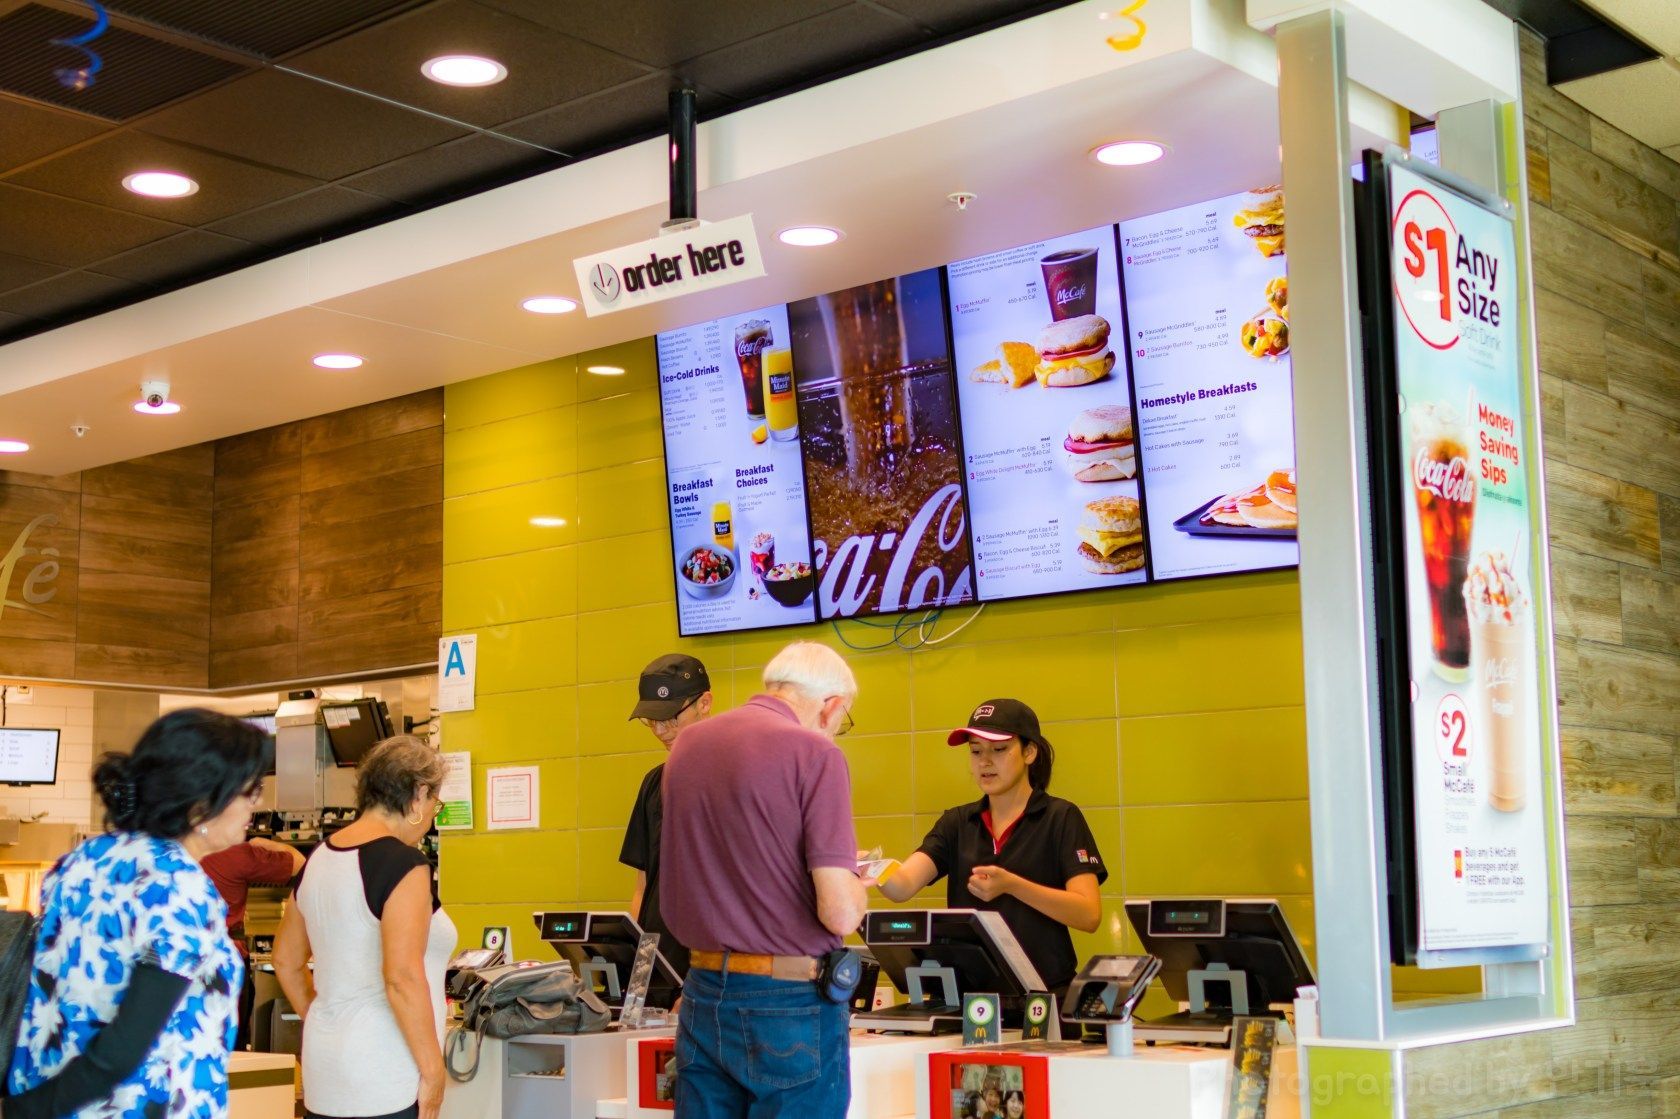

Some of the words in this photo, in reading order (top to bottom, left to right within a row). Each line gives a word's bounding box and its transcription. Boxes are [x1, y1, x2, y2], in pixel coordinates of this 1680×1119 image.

[1125, 238, 1130, 247] 7
[622, 253, 682, 292] order
[686, 239, 745, 276] here
[1126, 256, 1132, 265] 8
[1455, 233, 1498, 291] Any
[955, 304, 960, 312] 1
[1457, 277, 1500, 328] Size
[1137, 331, 1143, 340] 9
[1144, 326, 1166, 336] Sausage
[1136, 349, 1146, 358] 10
[662, 369, 694, 384] Ice-Cold
[694, 364, 720, 377] Drinks
[773, 382, 788, 392] Maid
[1141, 391, 1196, 409] Homestyle
[1198, 381, 1258, 400] Breakfasts
[1478, 403, 1514, 438] Money
[1182, 438, 1205, 446] Sausage
[1480, 430, 1519, 466] Saving
[968, 455, 974, 464] 2
[735, 463, 775, 478] Breakfast
[969, 472, 975, 480] 3
[1414, 446, 1475, 504] Coca-Cola
[1481, 458, 1508, 486] Sips
[672, 478, 714, 493] Breakfast
[736, 476, 768, 488] Choices
[673, 492, 699, 505] Bowls
[976, 535, 981, 544] 4
[977, 552, 983, 561] 5
[979, 568, 985, 577] 6
[444, 641, 466, 678] A
[1465, 862, 1496, 874] beverages
[1497, 861, 1509, 871] and
[1470, 875, 1486, 886] FREE
[1488, 875, 1500, 885] with
[491, 935, 498, 945] 8
[977, 1006, 985, 1017] 9
[1032, 1006, 1043, 1016] 13
